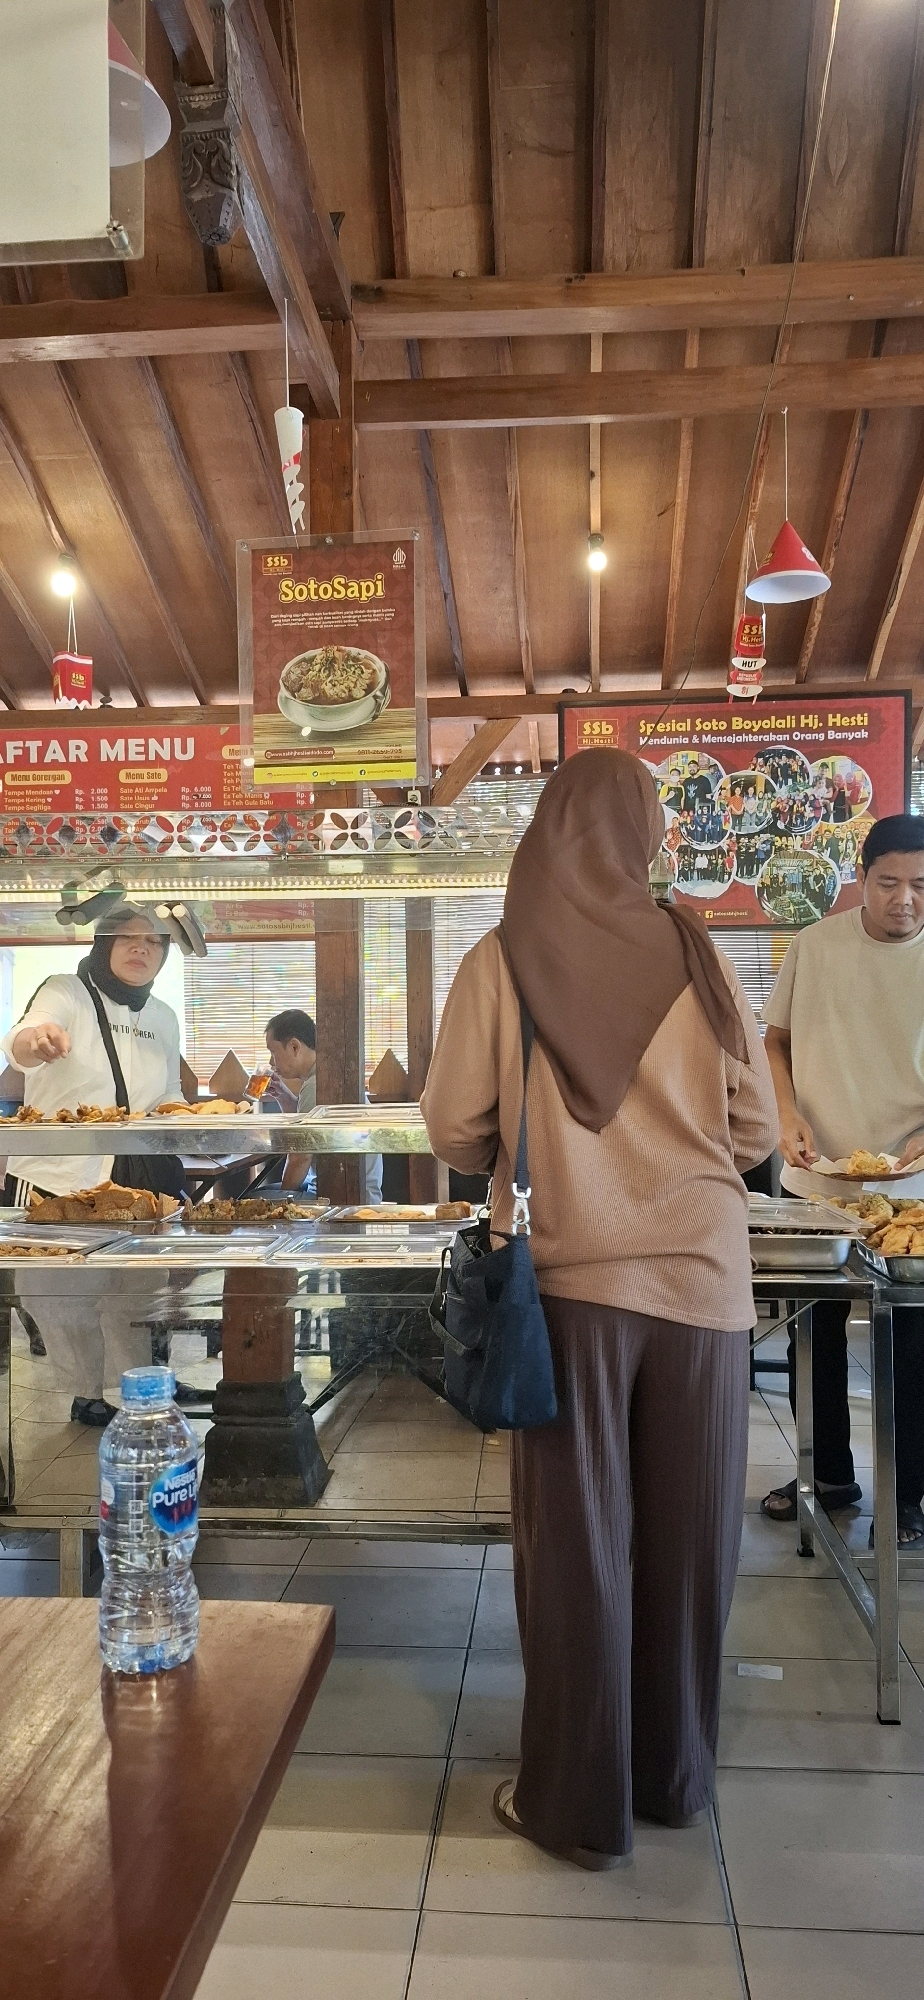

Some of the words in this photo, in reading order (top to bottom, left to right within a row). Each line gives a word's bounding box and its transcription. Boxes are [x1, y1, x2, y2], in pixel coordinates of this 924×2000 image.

[742, 660, 757, 668] HUT
[583, 721, 613, 735] SSb
[640, 719, 690, 735] Spesial
[695, 718, 727, 731] Soto
[732, 715, 796, 732] Boyolali
[800, 714, 823, 729] Hj.
[828, 713, 868, 726] Hesti
[692, 735, 699, 743] &
[702, 732, 789, 744] Mensejahterakan
[793, 732, 824, 741] Orang
[828, 729, 868, 740] Banyak
[100, 738, 195, 762] MENU
[10, 774, 30, 782] Menu
[125, 772, 144, 780] Menu
[152, 1488, 188, 1508] Pure
